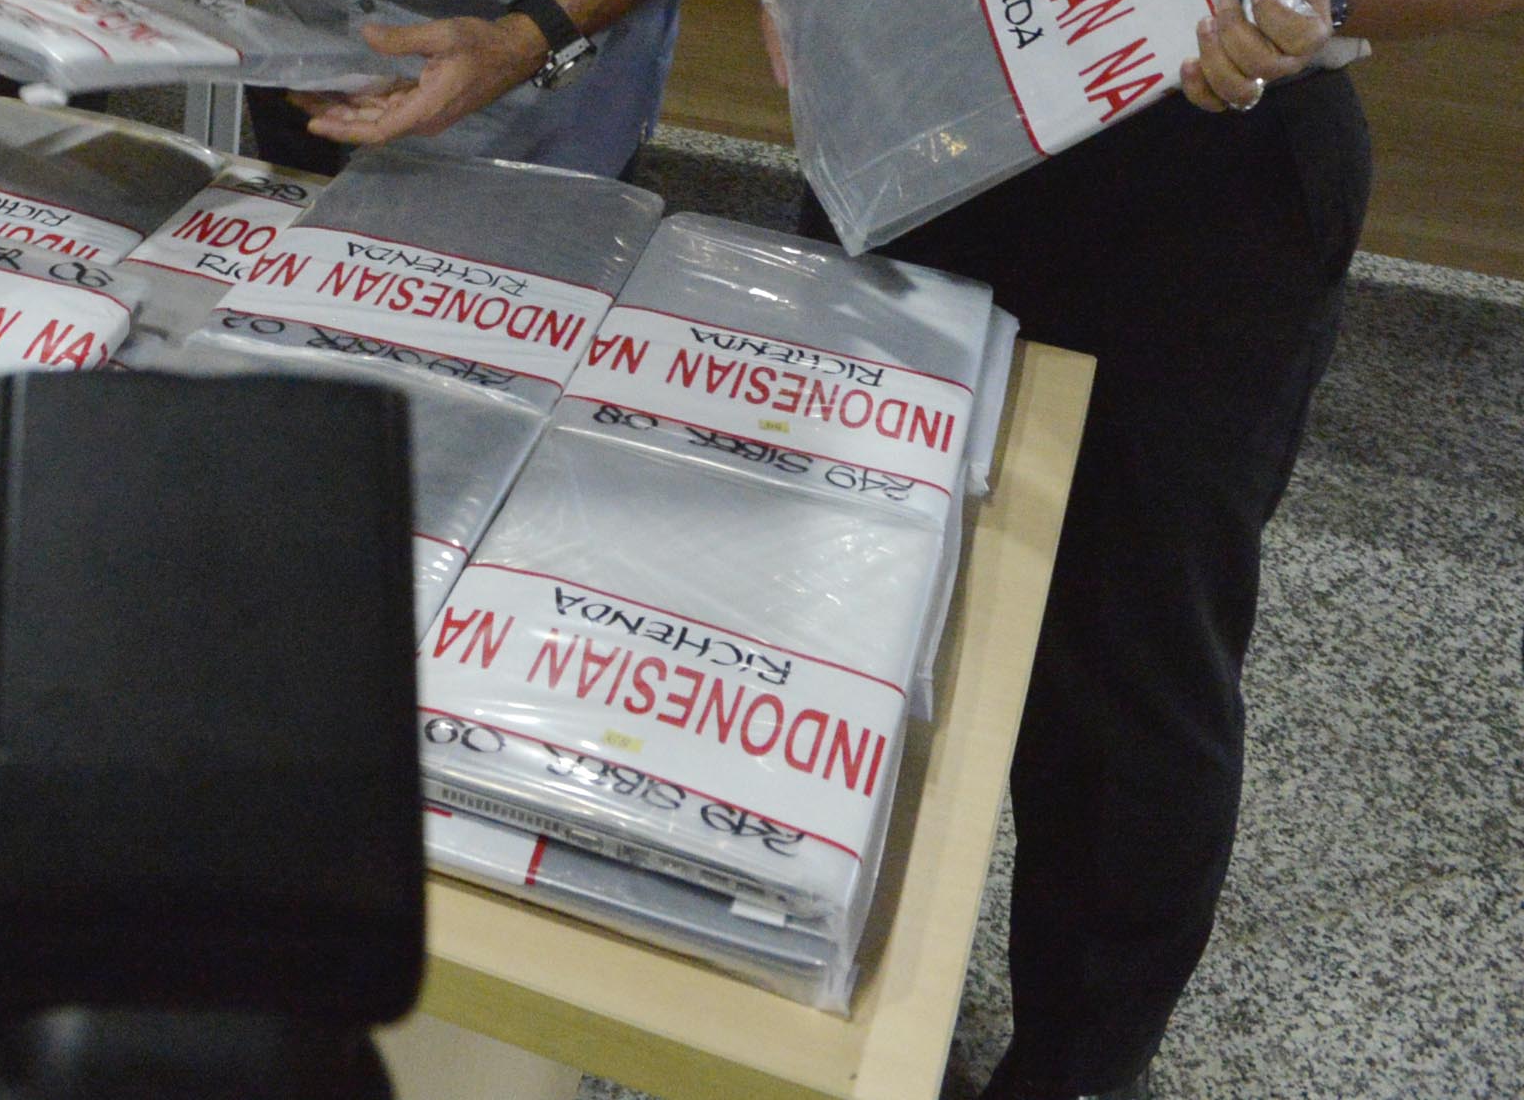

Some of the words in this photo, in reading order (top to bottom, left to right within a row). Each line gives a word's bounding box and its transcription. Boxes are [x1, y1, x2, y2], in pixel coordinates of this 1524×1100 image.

[1079, 37, 1164, 123] NA
[172, 209, 277, 254] INDO
[248, 251, 312, 287] NA
[347, 241, 530, 298] RICHENDA
[221, 308, 285, 336] 02
[316, 261, 586, 352] INDONESIAN
[586, 334, 650, 374] NA
[690, 327, 885, 387] RICHENDA
[592, 404, 659, 430] 08
[665, 348, 955, 453] INDONESIAN
[824, 464, 915, 501] 249
[432, 606, 515, 669] NA
[554, 586, 792, 686] RICHENDA
[527, 627, 886, 797] INDONESIAN
[700, 802, 805, 857] 249
